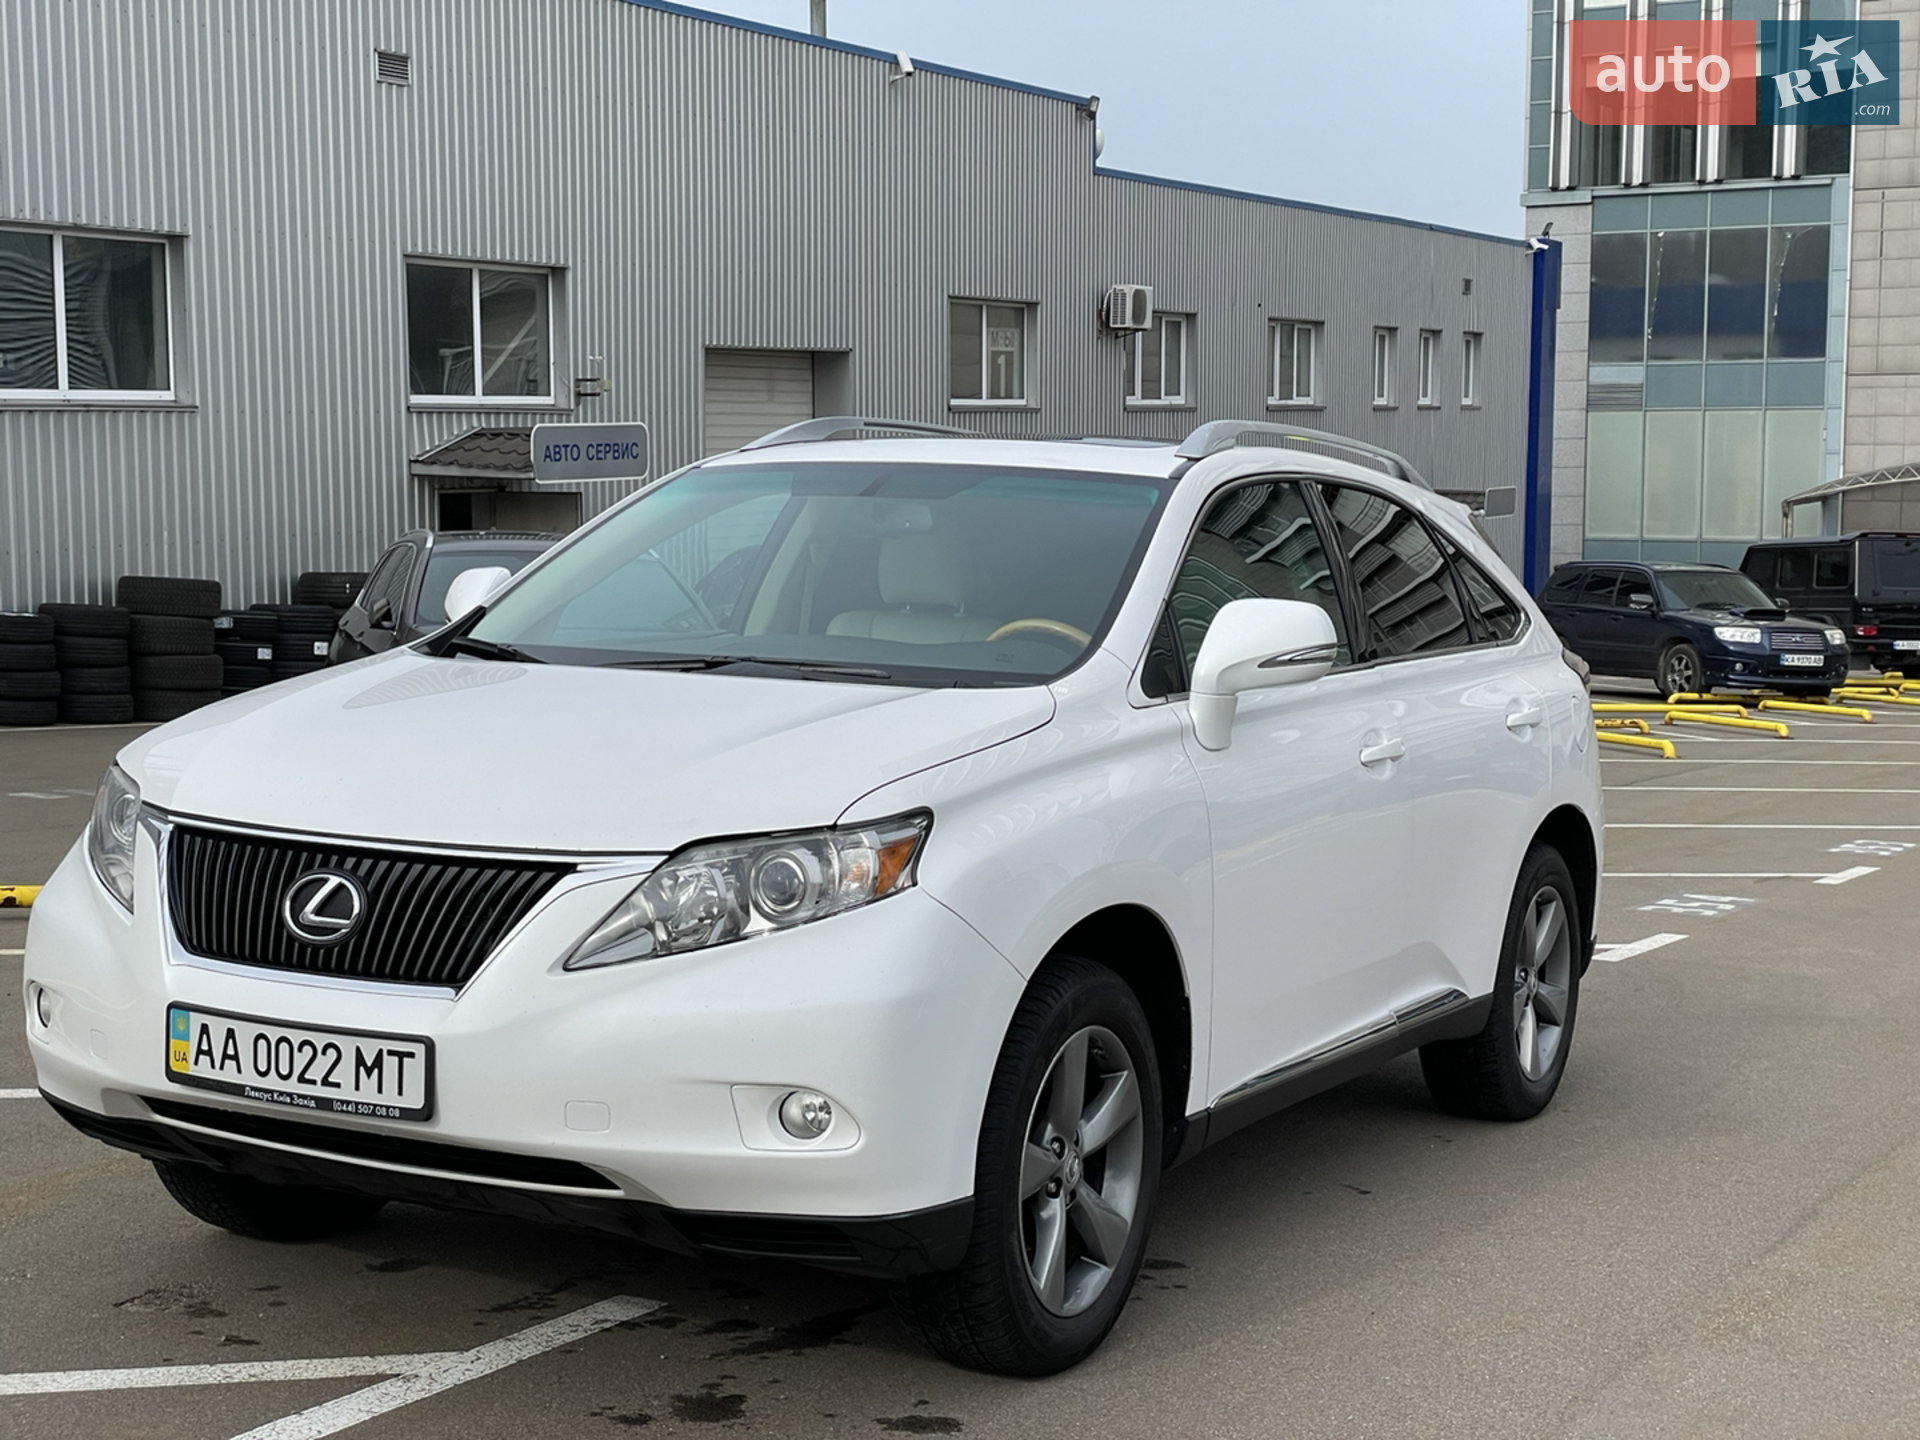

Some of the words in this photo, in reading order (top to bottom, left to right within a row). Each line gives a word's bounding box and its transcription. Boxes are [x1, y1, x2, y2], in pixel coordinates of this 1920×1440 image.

[543, 443, 581, 462] АВТО
[586, 442, 639, 461] СЕРВИС
[174, 1050, 189, 1064] UA
[193, 1022, 243, 1075] AA
[253, 1032, 343, 1089] 0022
[354, 1044, 416, 1097] MT
[244, 1086, 273, 1101] Лексус
[273, 1091, 291, 1104] Київ
[292, 1094, 317, 1108] Захід
[332, 1100, 356, 1113] (044)
[357, 1104, 374, 1115] 507
[375, 1106, 387, 1116] 08
[388, 1107, 400, 1118] 08
